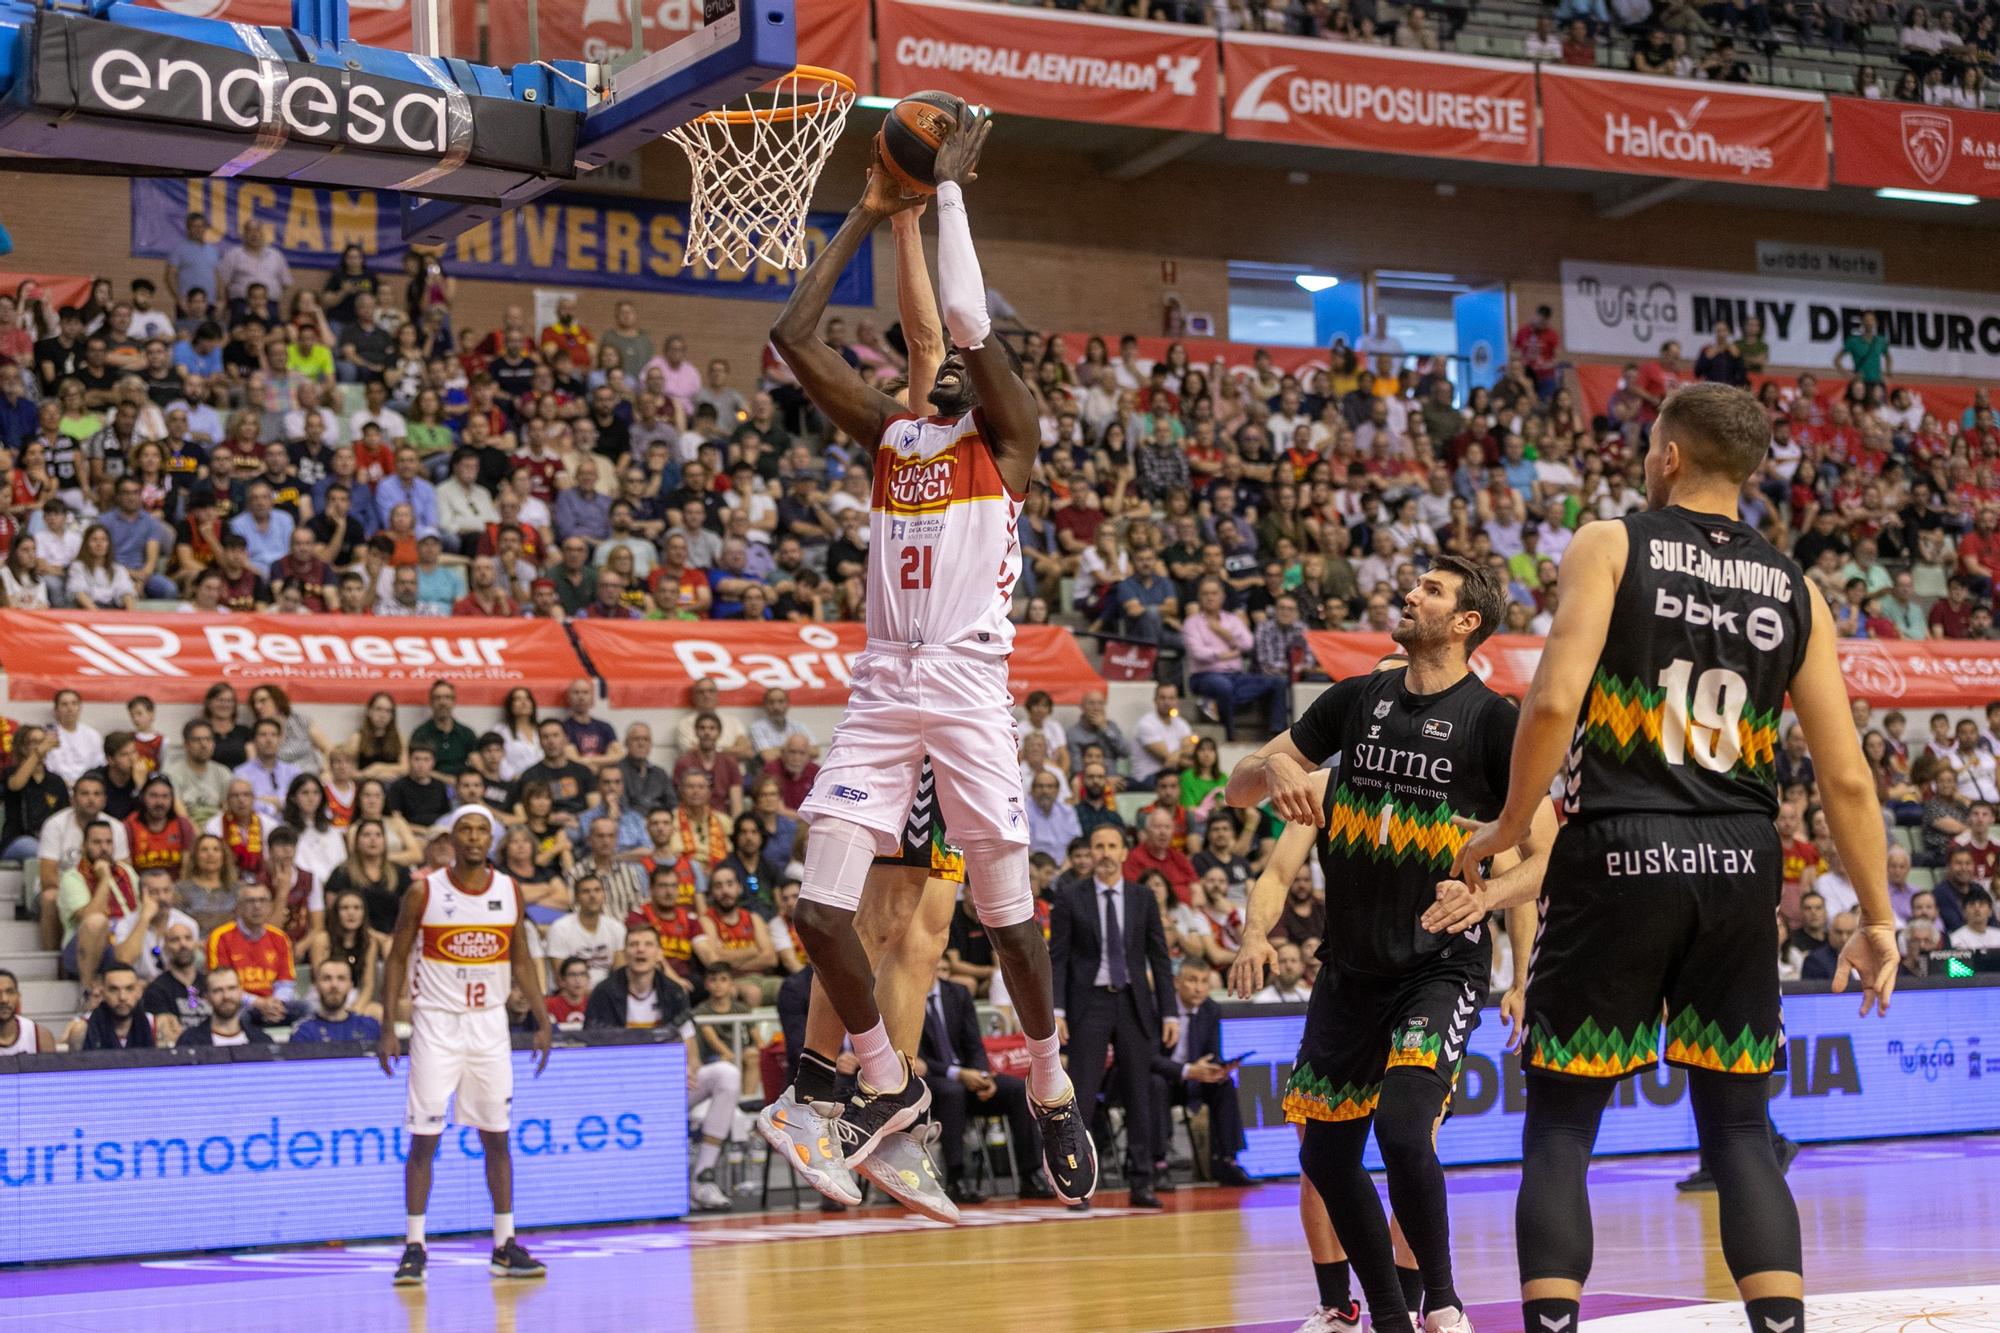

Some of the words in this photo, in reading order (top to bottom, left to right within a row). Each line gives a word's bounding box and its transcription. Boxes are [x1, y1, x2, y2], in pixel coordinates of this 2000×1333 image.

[896, 36, 1158, 93] COMPRALAENTRADA
[91, 48, 447, 152] endesa
[1288, 76, 1527, 135] GRUPOSURESTE
[187, 177, 378, 255] UCAM
[1828, 253, 1878, 275] Norte
[1691, 294, 1796, 341] MUY
[898, 462, 950, 484] UCAM
[900, 545, 933, 590] 21
[1649, 538, 1793, 604] SULEJMANOVIC
[1654, 587, 1740, 635] bbk
[203, 625, 509, 667] Renesur
[1657, 658, 1748, 774] 19
[1353, 742, 1453, 784] surne
[842, 786, 869, 802] ESP
[1352, 774, 1383, 789] seguros
[1384, 781, 1392, 791] &
[1394, 782, 1449, 801] pensiones
[1378, 803, 1394, 845] 1
[1606, 841, 1757, 877] euskaltax
[453, 931, 498, 946] UCAM
[465, 982, 486, 1009] 12
